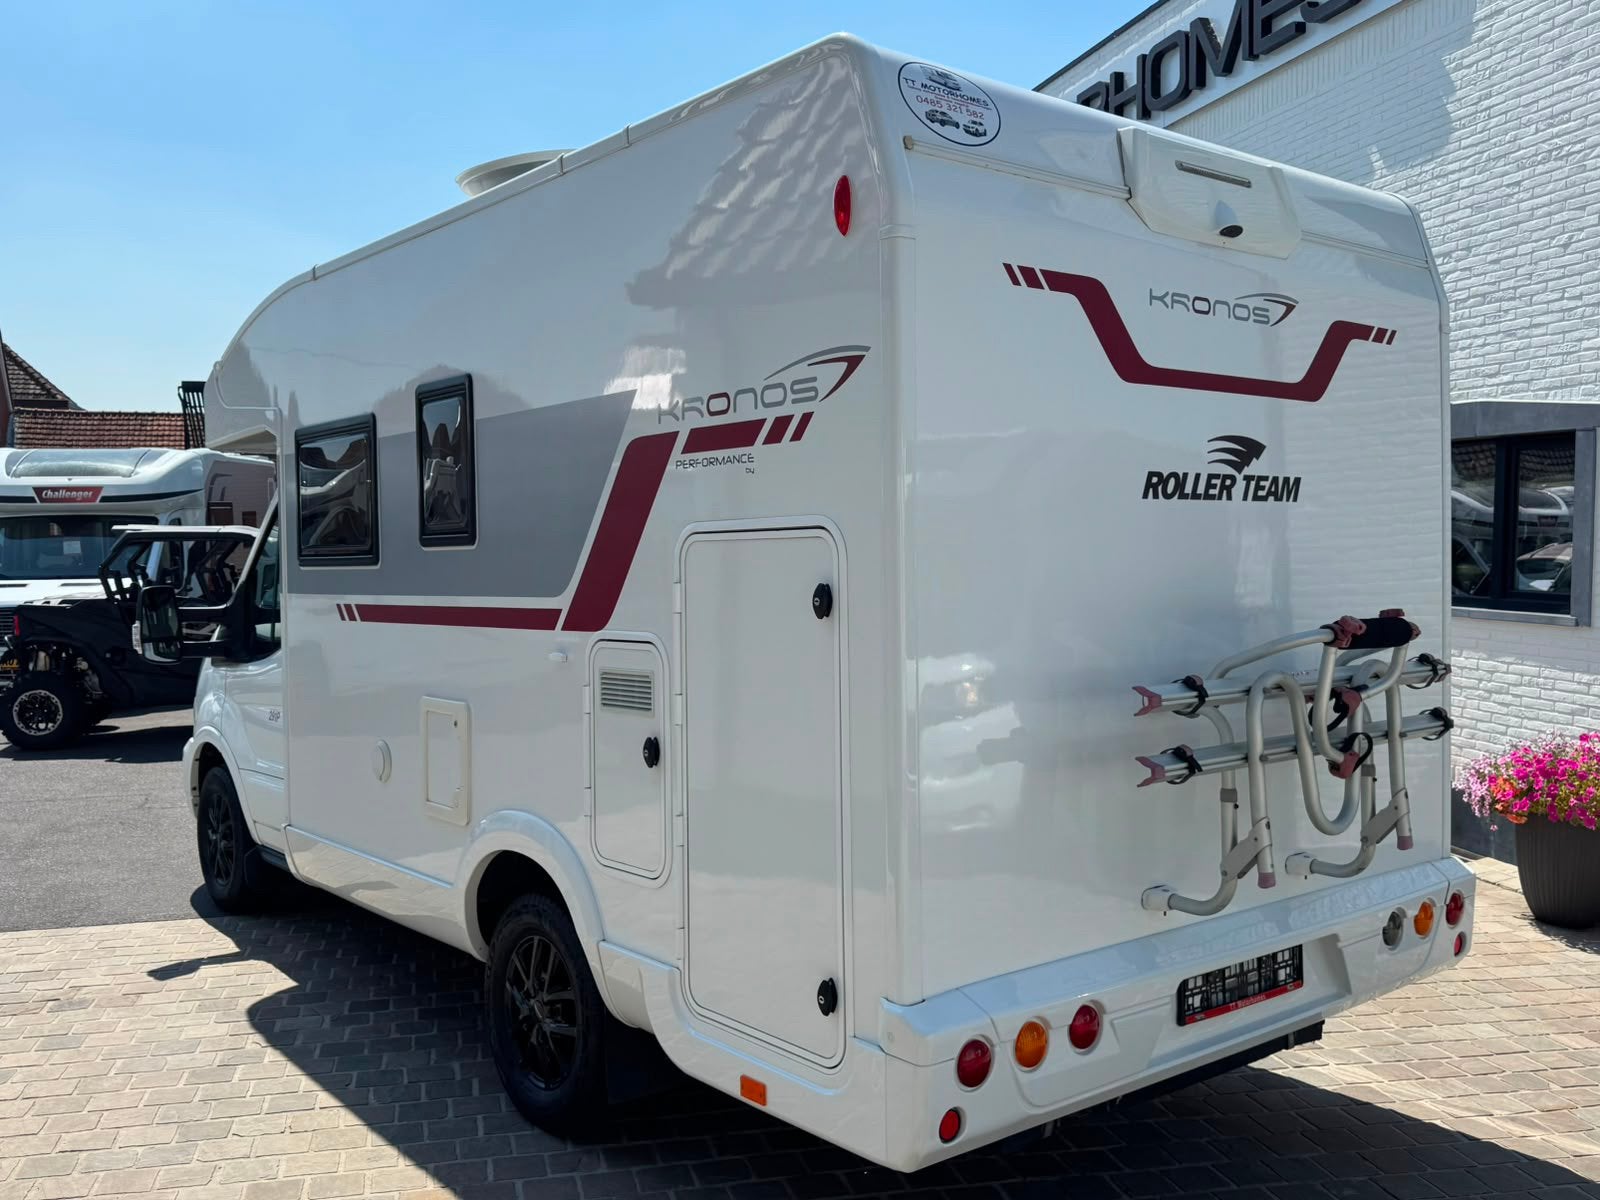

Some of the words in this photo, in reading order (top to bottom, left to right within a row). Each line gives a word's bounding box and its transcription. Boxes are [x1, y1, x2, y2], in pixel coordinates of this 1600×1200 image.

[903, 77, 916, 87] TT
[921, 83, 989, 107] MOTORHOMES
[916, 95, 943, 109] 0485
[946, 104, 964, 115] 321
[966, 109, 985, 121] 582
[675, 453, 754, 469] PERFORMANCE
[745, 467, 755, 475] by
[42, 489, 93, 501] Challenger
[1142, 471, 1237, 502] ROLLER
[1241, 474, 1302, 503] TEAM
